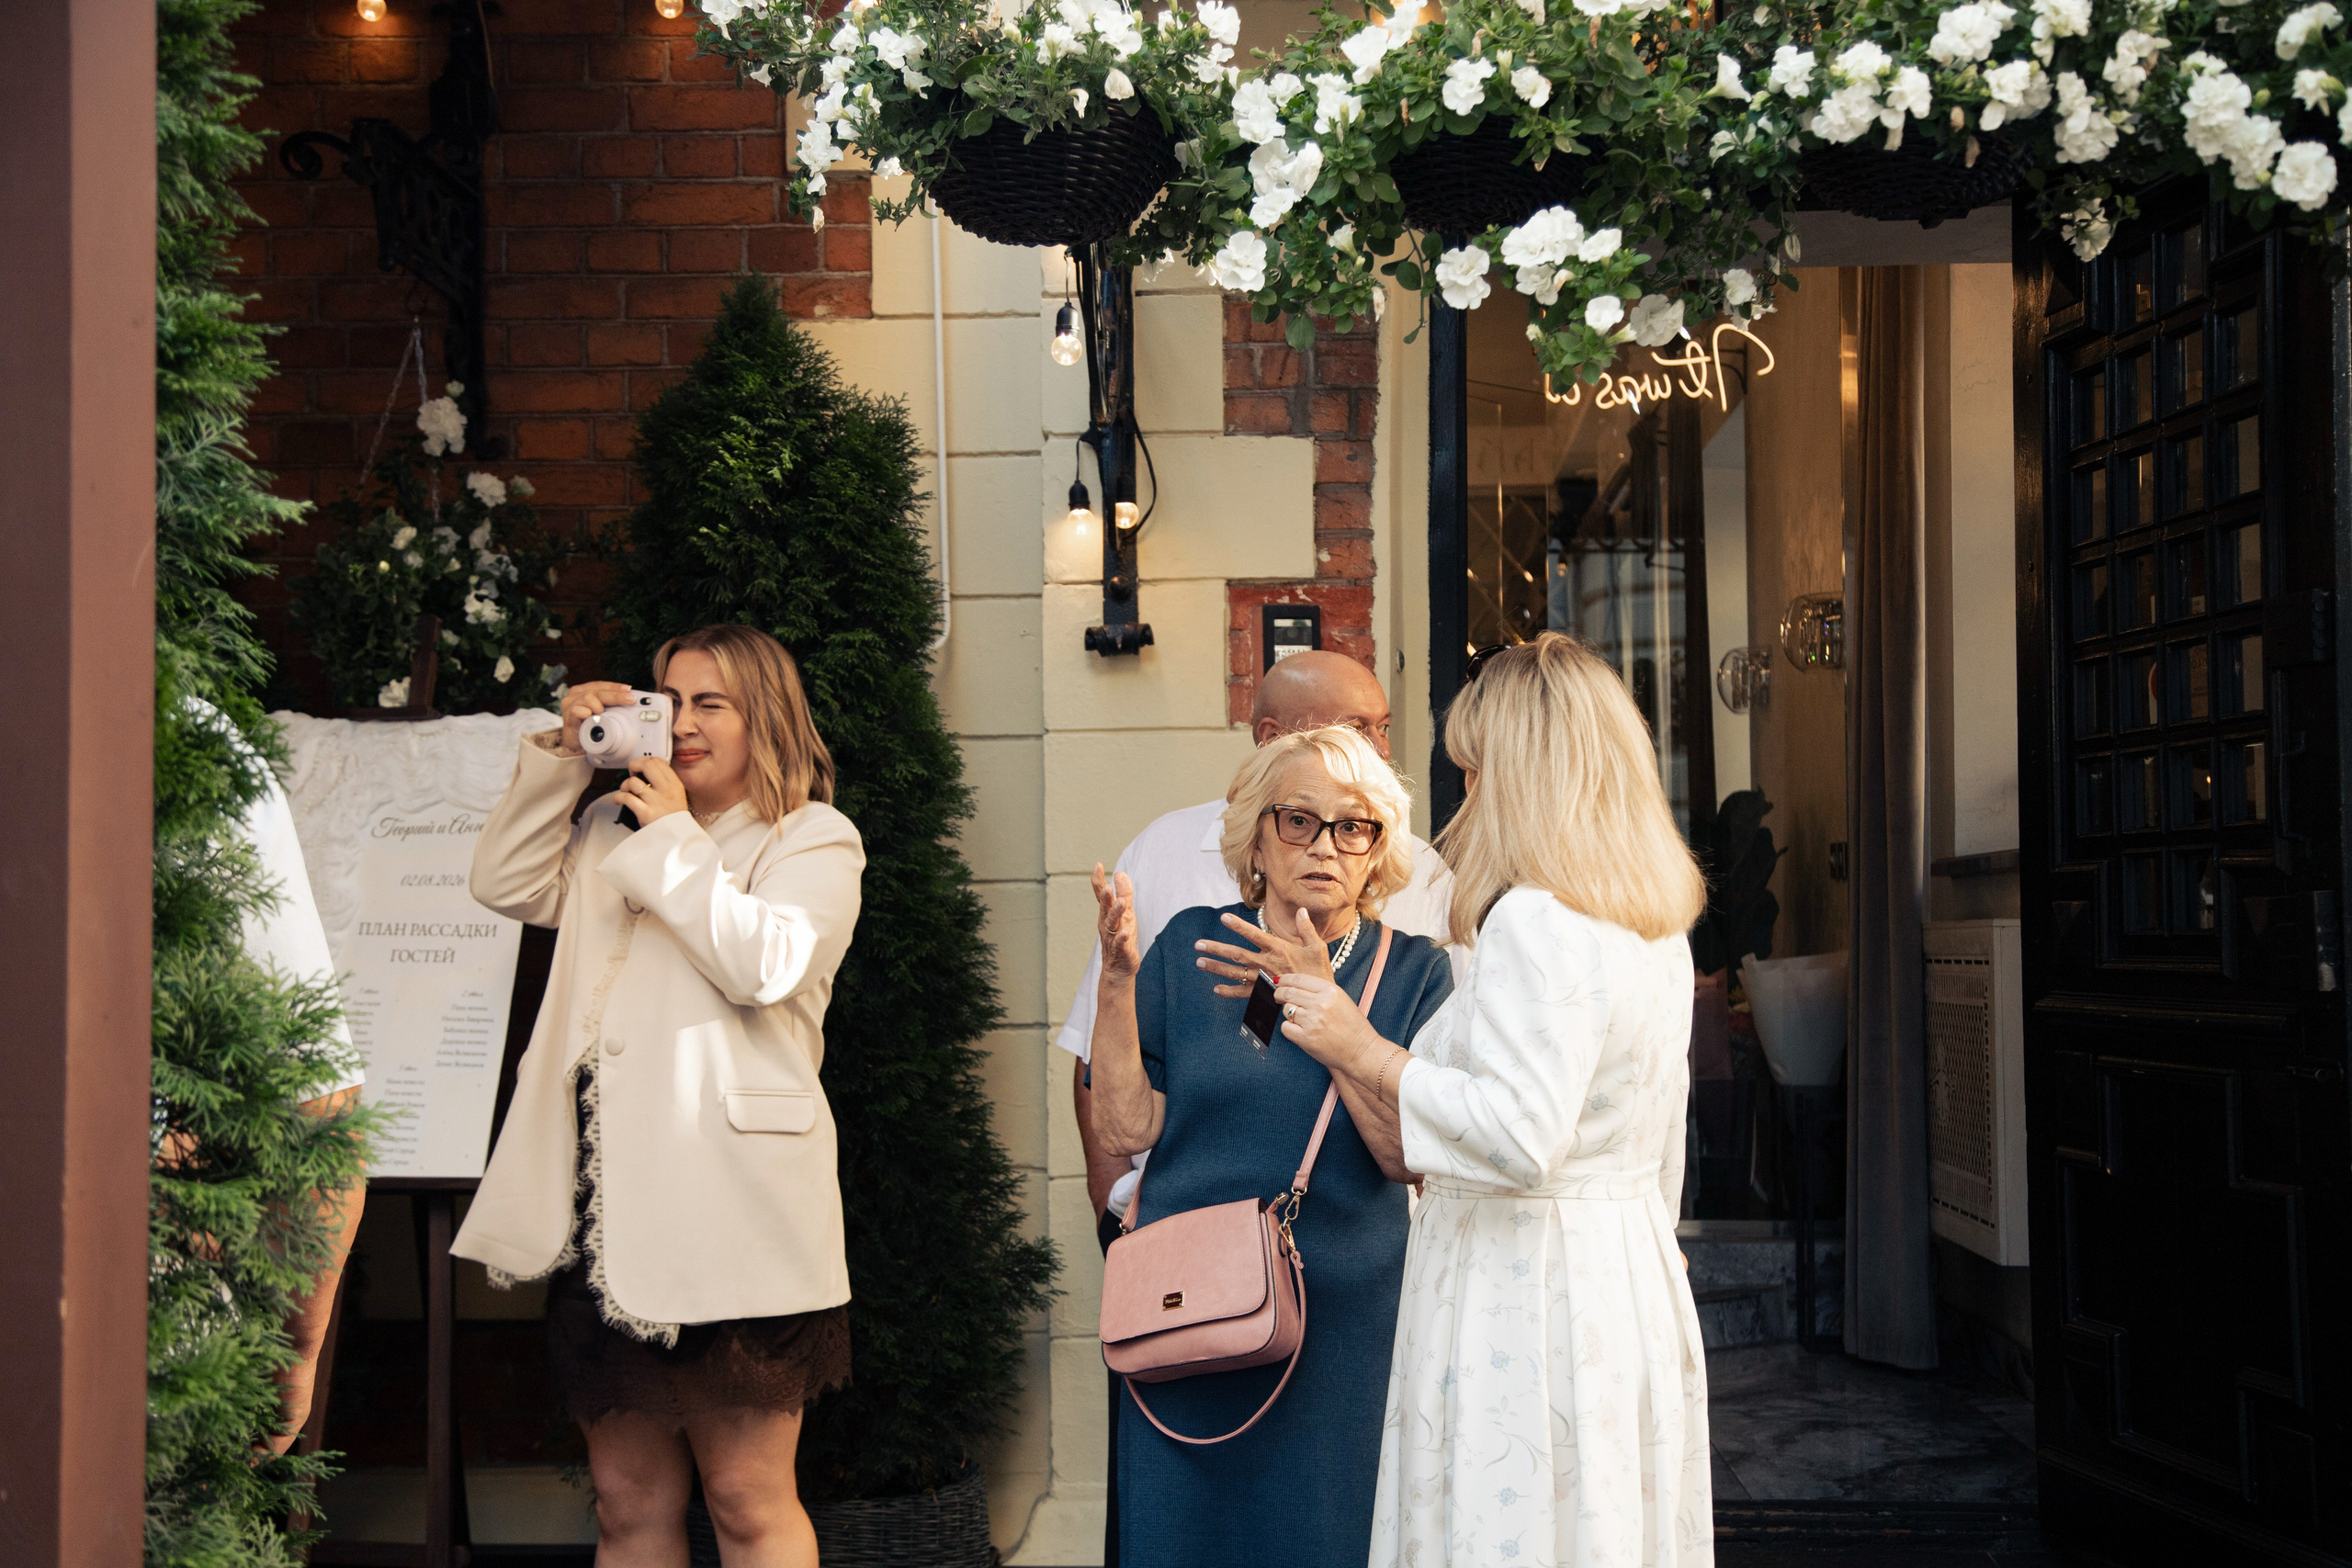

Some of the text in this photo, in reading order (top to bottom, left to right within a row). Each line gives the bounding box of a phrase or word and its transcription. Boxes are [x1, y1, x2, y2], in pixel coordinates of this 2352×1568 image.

[357, 921, 498, 939] ПЛАН РАССАДКИ
[390, 946, 456, 964] ГОСТЕЙ
